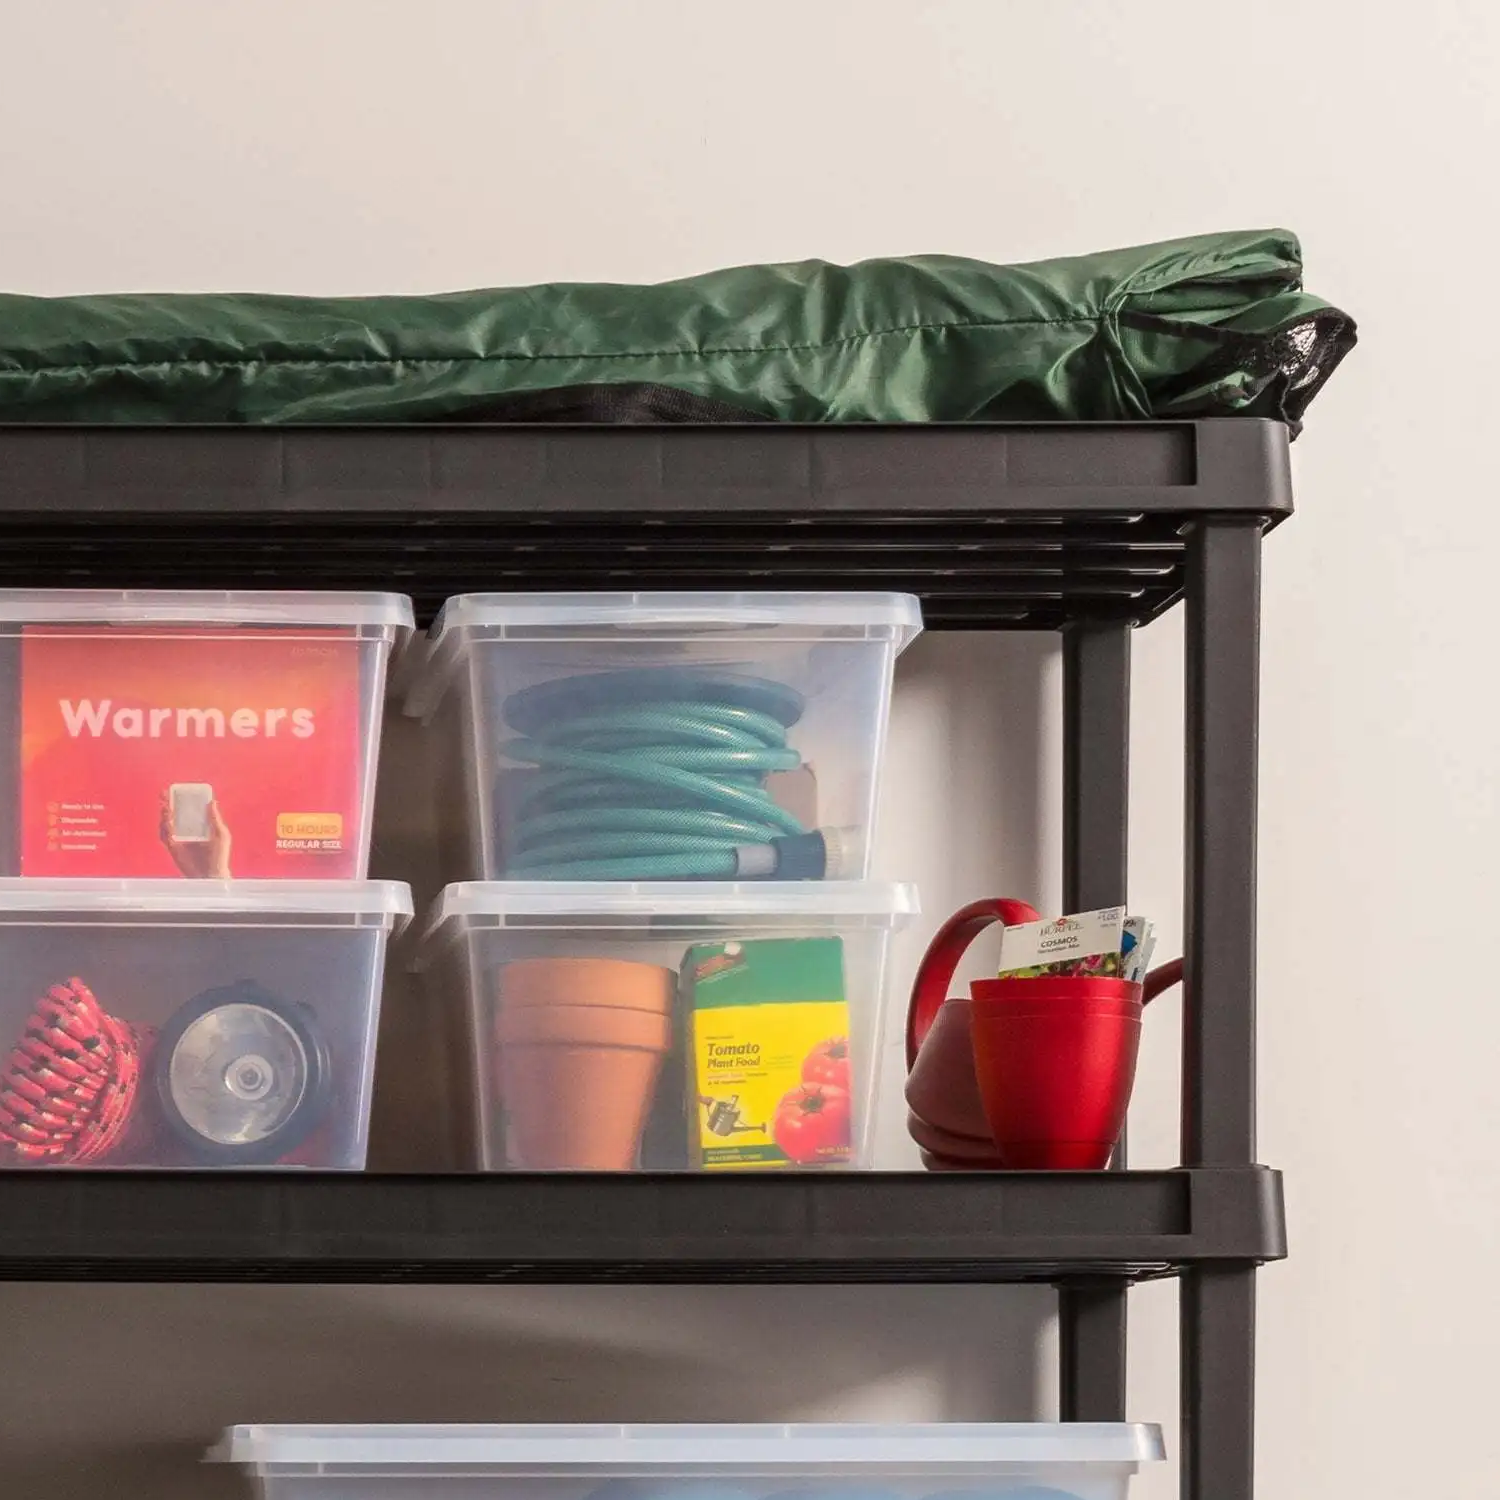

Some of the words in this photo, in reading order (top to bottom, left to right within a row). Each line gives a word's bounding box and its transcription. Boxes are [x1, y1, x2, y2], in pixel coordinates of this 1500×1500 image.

[59, 699, 315, 738] Warmers
[275, 840, 320, 849] REGULAR
[1041, 935, 1078, 949] COSMOS
[707, 1042, 760, 1057] Tomato
[707, 1058, 734, 1069] Plant
[735, 1056, 761, 1066] Food
